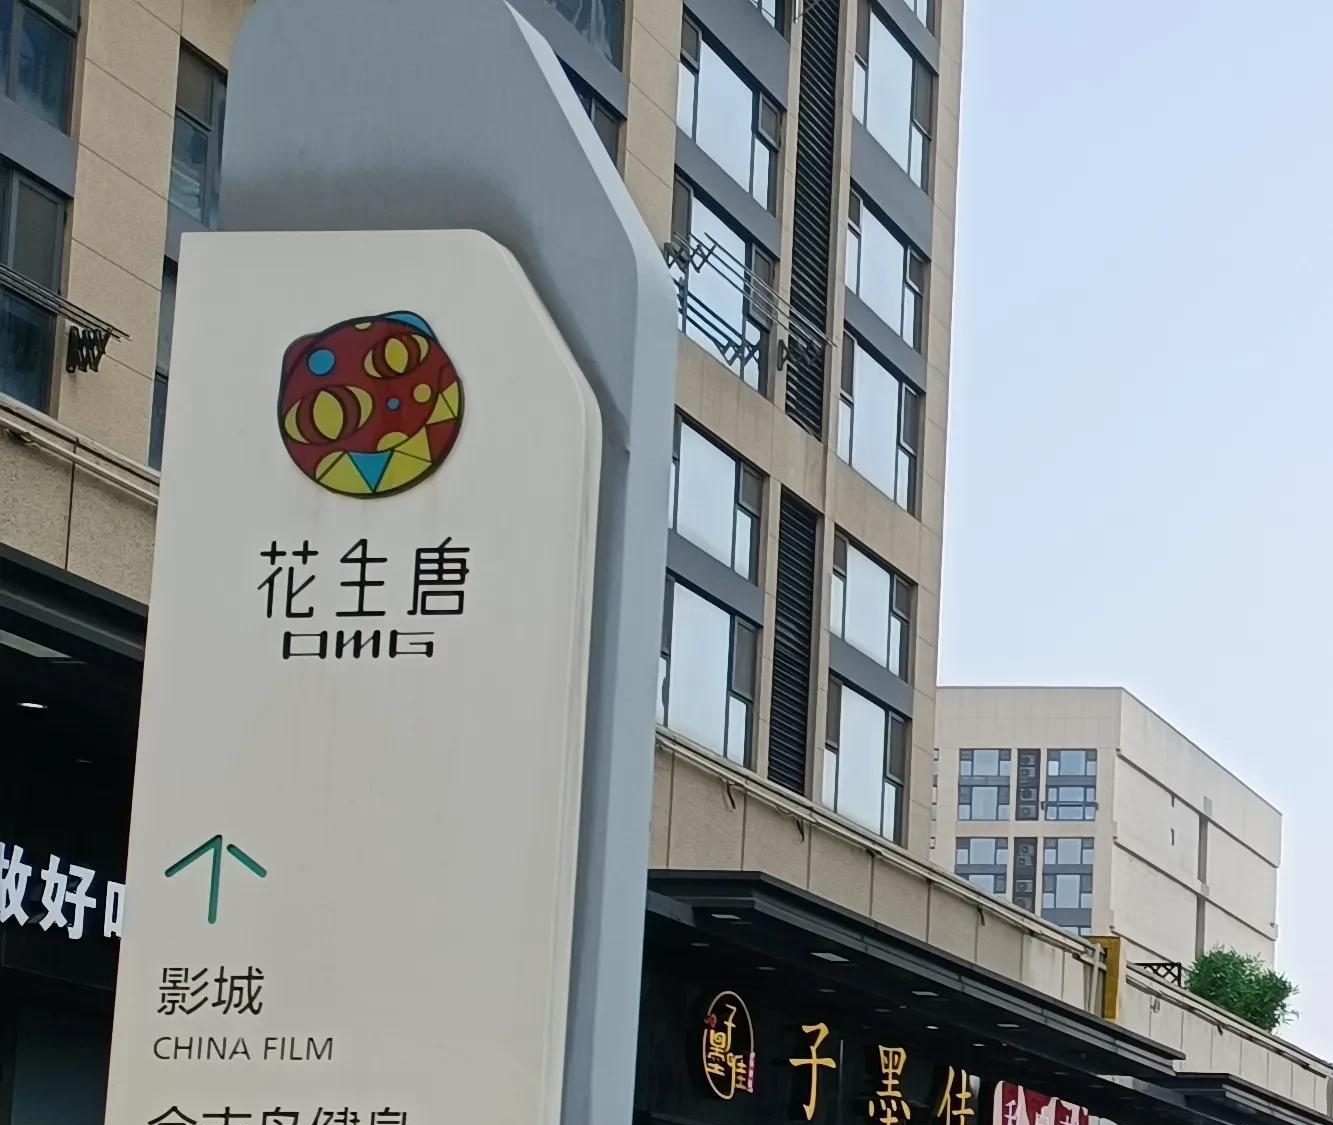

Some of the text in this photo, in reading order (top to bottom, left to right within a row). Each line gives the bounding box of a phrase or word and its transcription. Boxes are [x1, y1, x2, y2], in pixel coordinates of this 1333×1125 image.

[257, 536, 471, 618] 花生唐
[282, 629, 436, 660] OMG
[156, 965, 265, 1016] 影城
[153, 1036, 335, 1061] CHINA FILM
